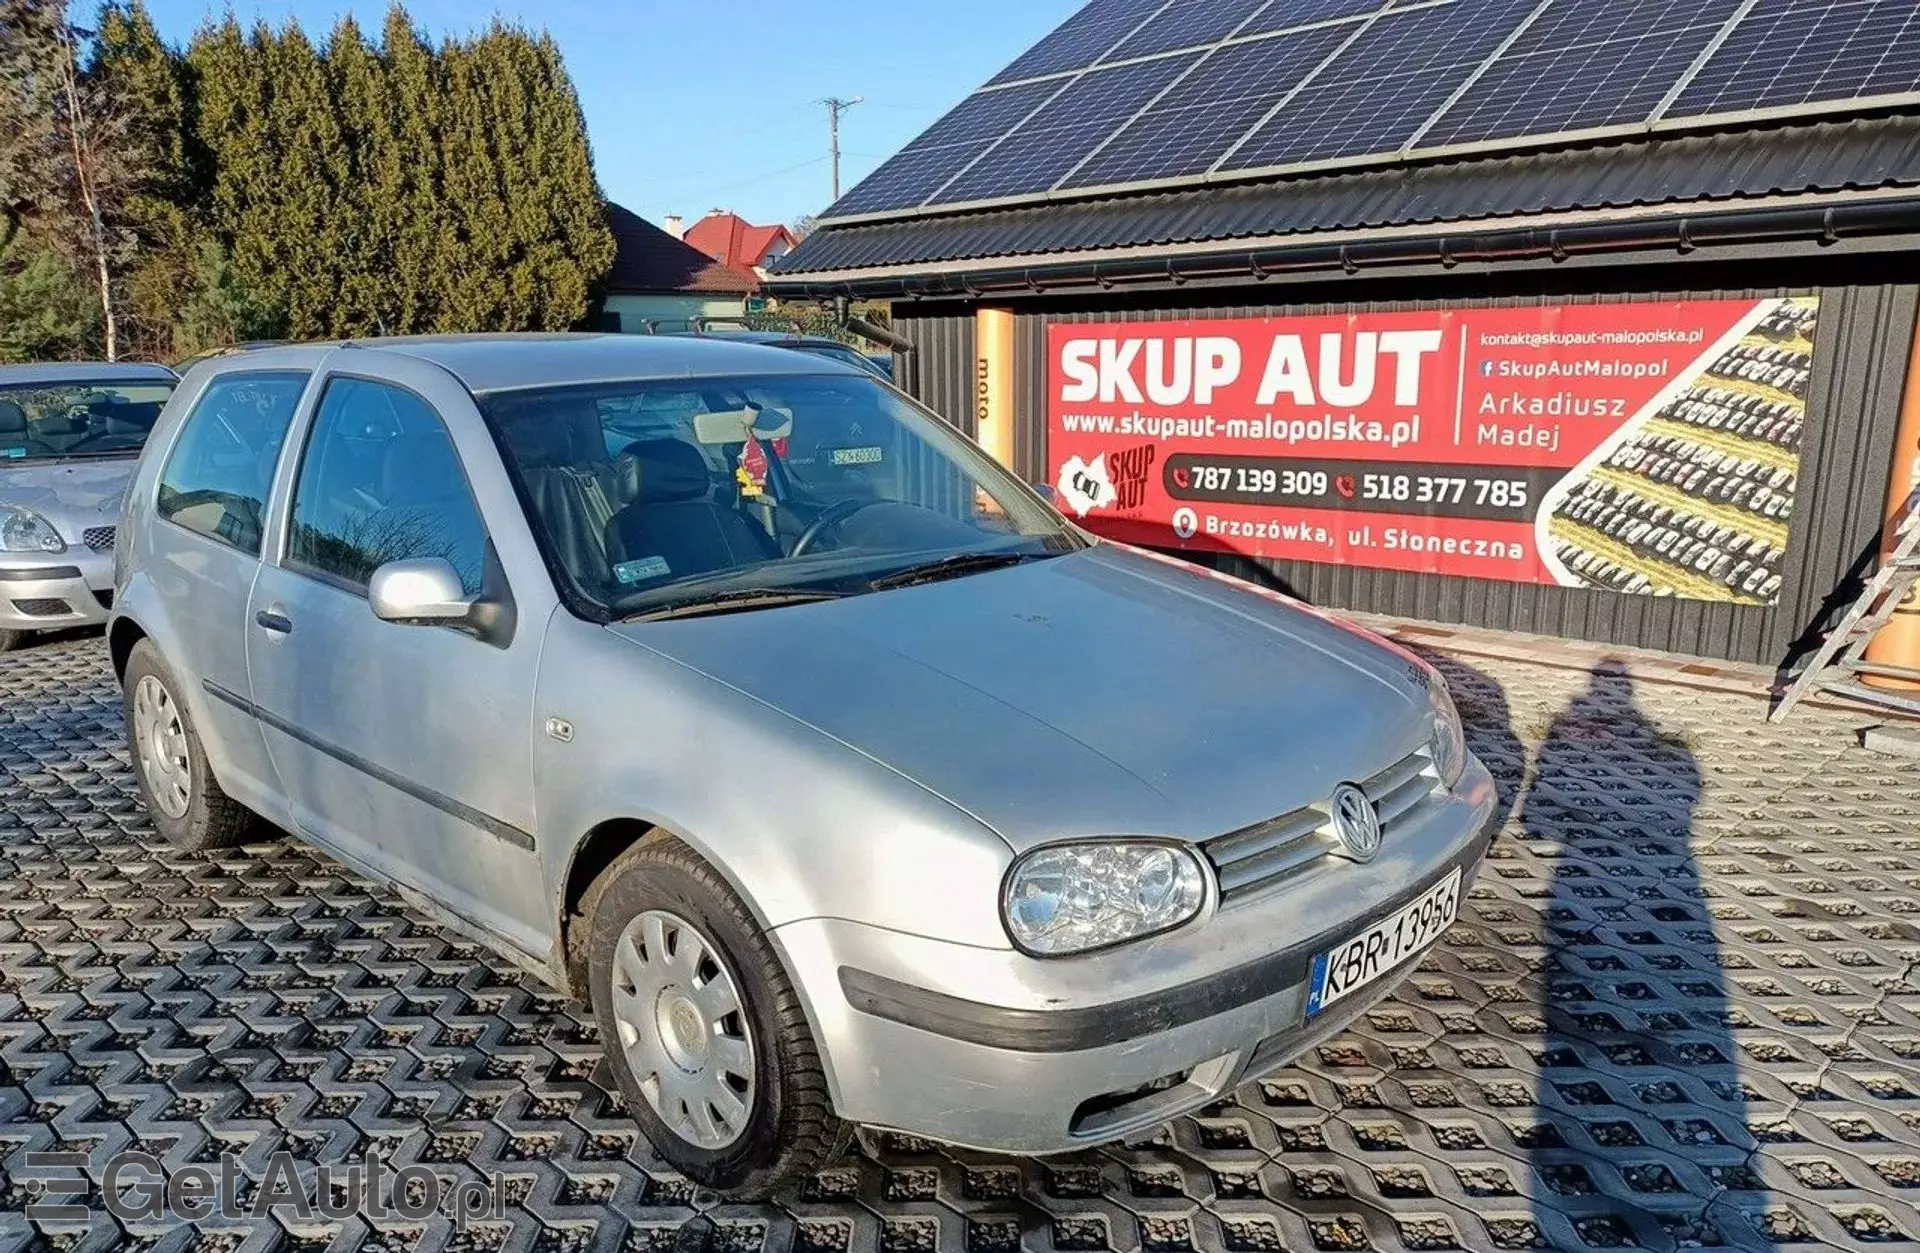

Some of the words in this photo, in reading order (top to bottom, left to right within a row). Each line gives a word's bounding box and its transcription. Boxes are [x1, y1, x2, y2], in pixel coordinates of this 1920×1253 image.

[1480, 328, 1704, 348] kontakt@skupaut-malopolska.pl
[1061, 337, 1242, 406] SKUP
[1255, 330, 1441, 407] AUT
[1499, 359, 1668, 379] SkupAutMalopol
[1479, 391, 1626, 416] Arkadiusz
[1062, 411, 1420, 448] www.skupaut-malopolska.pl
[1478, 423, 1560, 452] Madej
[1110, 444, 1155, 484] SKUP
[1192, 466, 1232, 491] 787
[1237, 468, 1276, 493] 139
[1281, 470, 1328, 496] 309
[1116, 478, 1148, 511] AUT
[1363, 473, 1410, 501] 518
[1415, 476, 1467, 504] 377
[1473, 479, 1527, 508] 785
[1205, 515, 1335, 547] Brzozówka,
[1348, 525, 1377, 548] ul.
[1384, 528, 1524, 560] Słoneczna
[1325, 931, 1384, 1000] KBR
[1392, 874, 1457, 960] 13956
